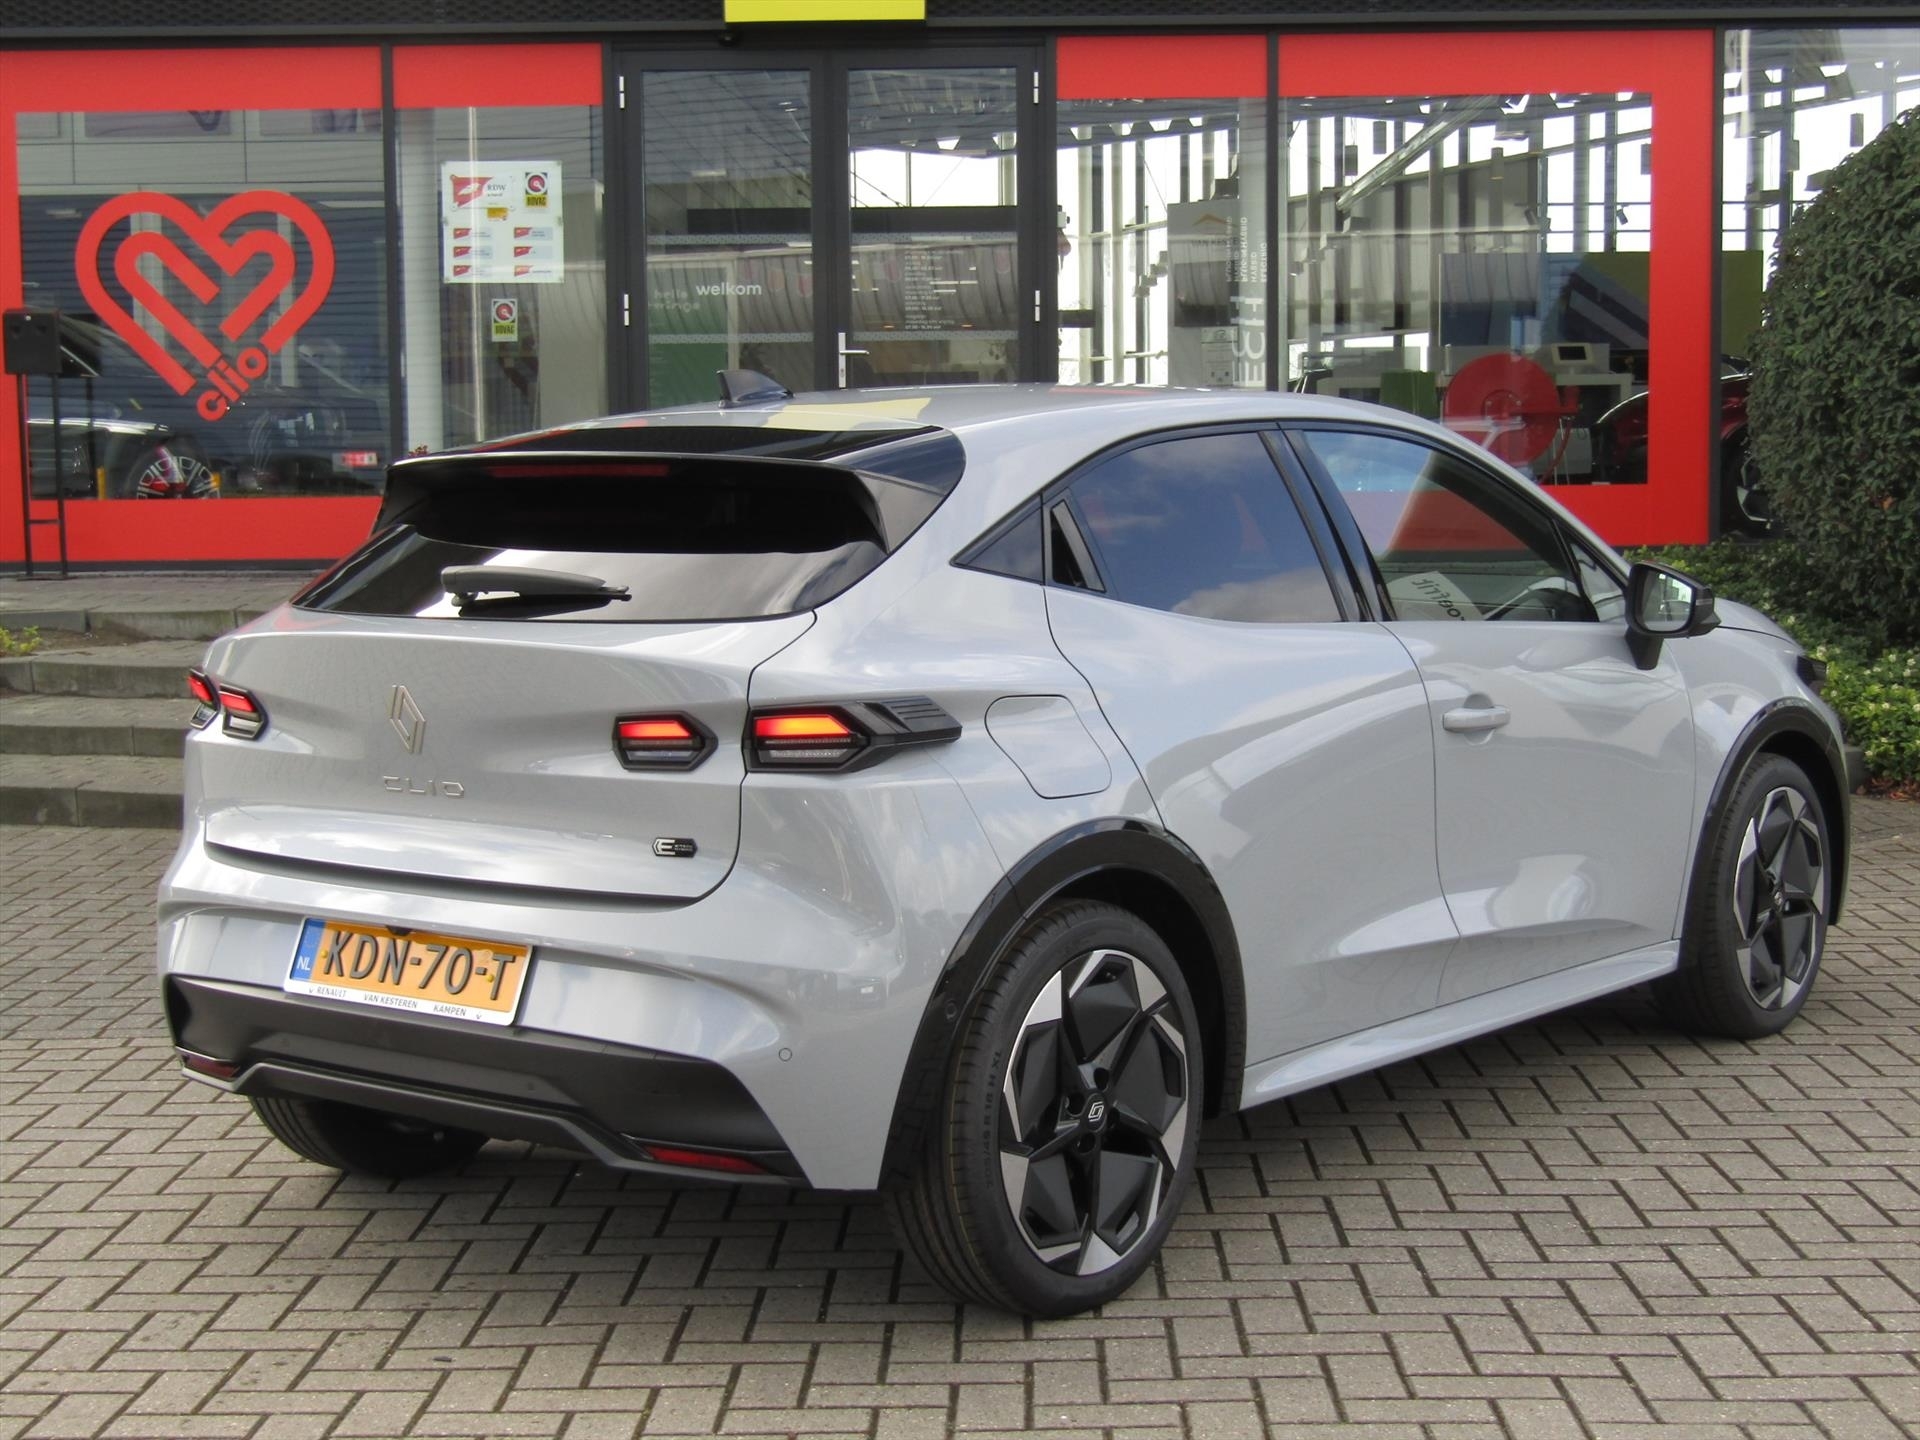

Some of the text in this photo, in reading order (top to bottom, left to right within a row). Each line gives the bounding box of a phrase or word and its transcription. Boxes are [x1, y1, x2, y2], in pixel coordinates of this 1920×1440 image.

[695, 281, 762, 296] welkom
[196, 346, 268, 422] clio
[382, 774, 466, 798] CLIO
[296, 955, 311, 972] NL
[322, 929, 516, 1001] KDN-70-T
[316, 986, 347, 998] RENAULT
[363, 993, 418, 1010] VAN KESTEREN
[432, 1004, 467, 1018] KAMPEN
